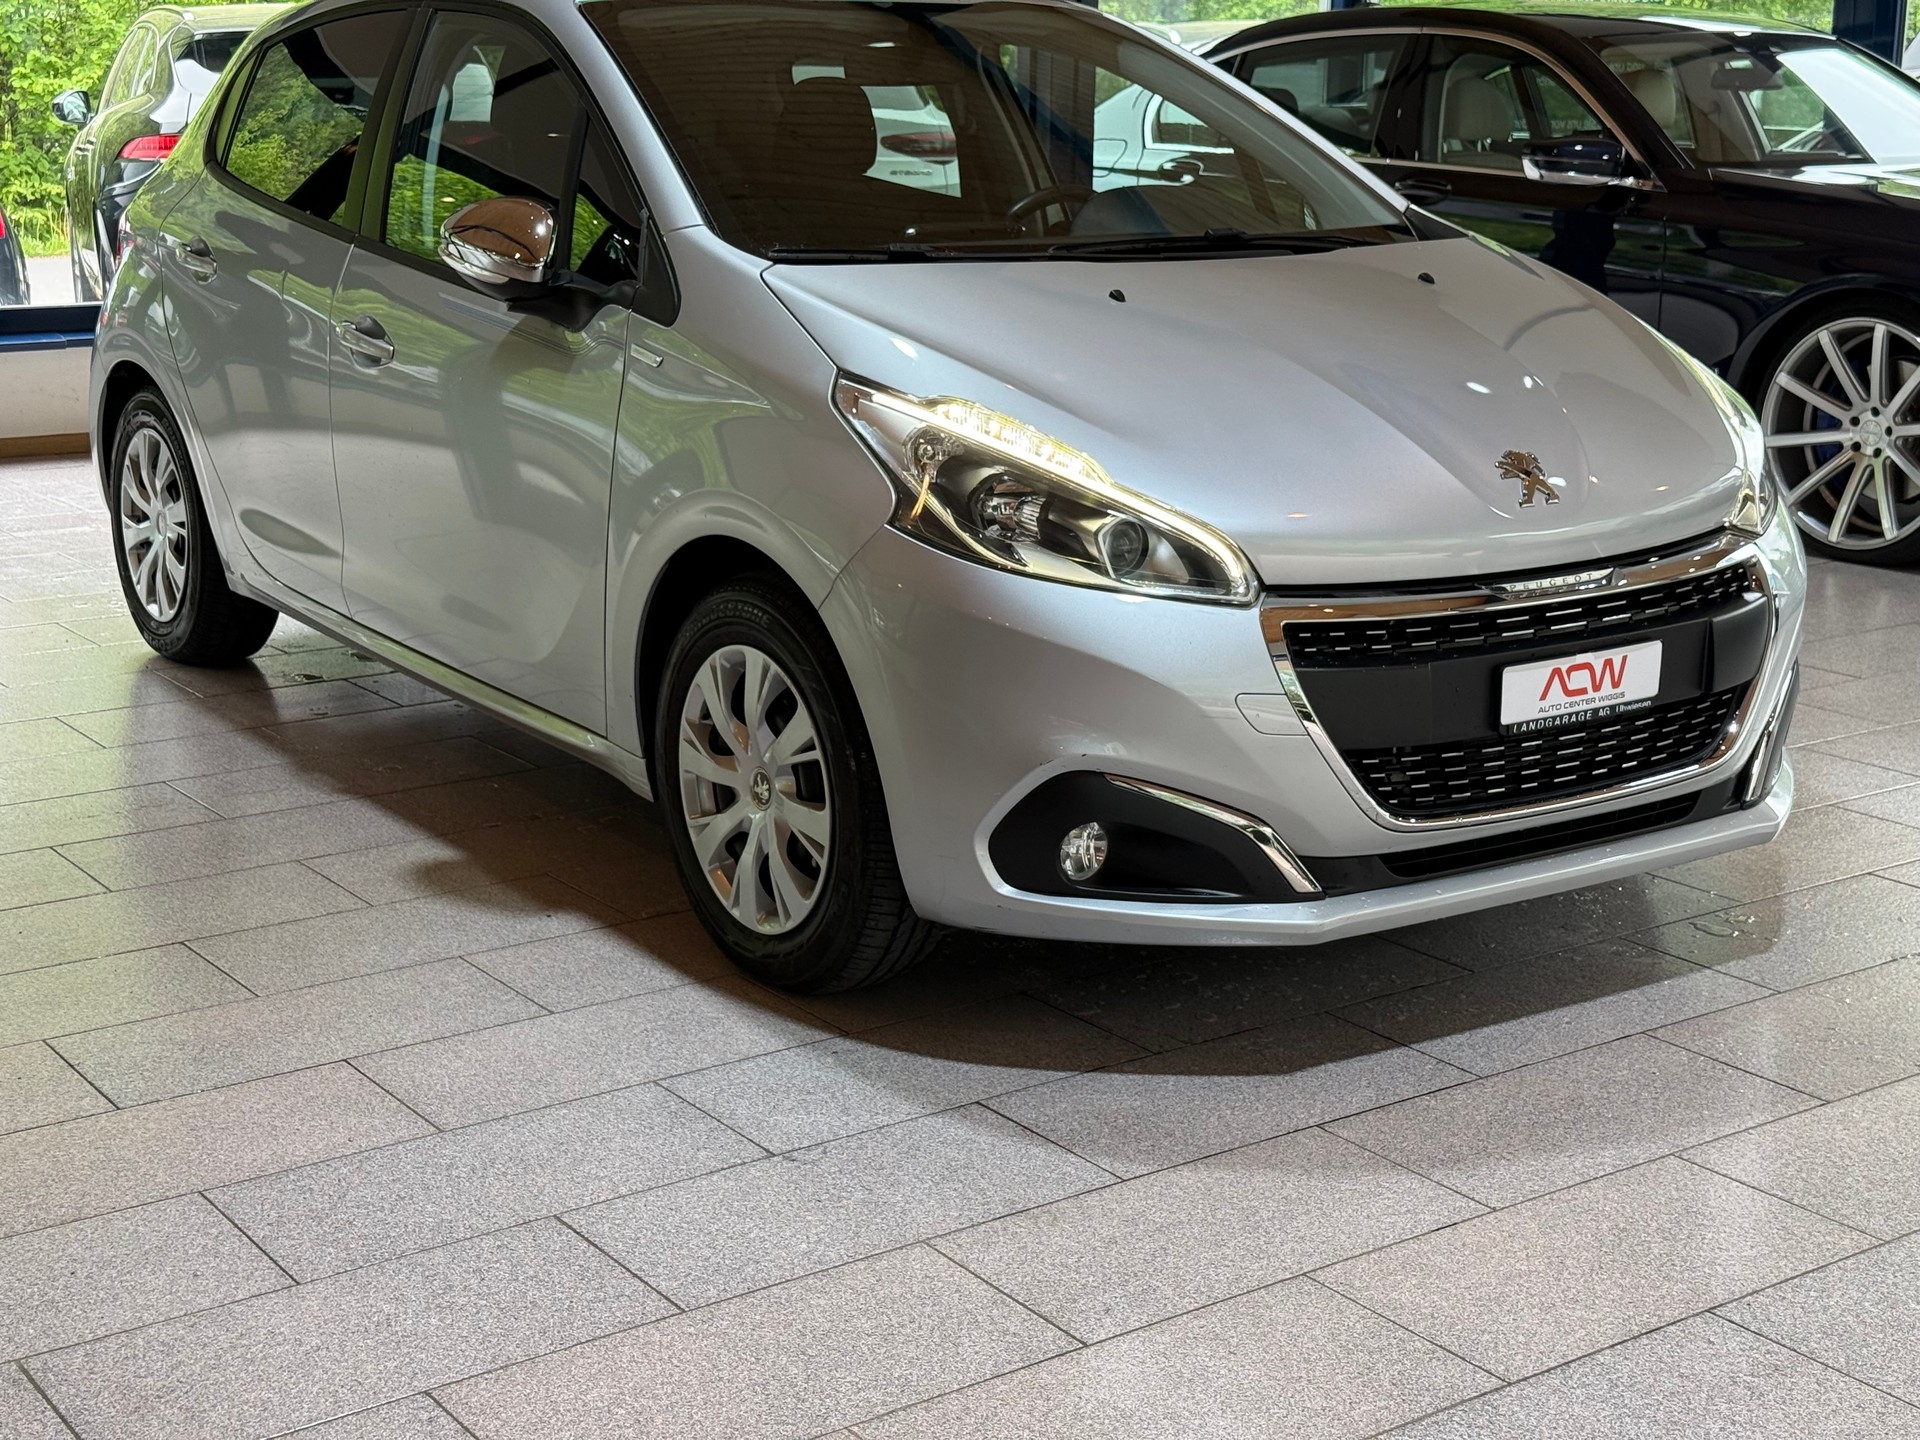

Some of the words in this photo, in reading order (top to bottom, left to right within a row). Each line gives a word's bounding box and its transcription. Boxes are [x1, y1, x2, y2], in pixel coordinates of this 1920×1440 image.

[1510, 573, 1593, 592] PEUGEOT
[1539, 655, 1628, 701] ACW
[1538, 703, 1562, 714] AUTO
[1563, 697, 1597, 710] CENTER
[1597, 691, 1626, 703] WIGGIS
